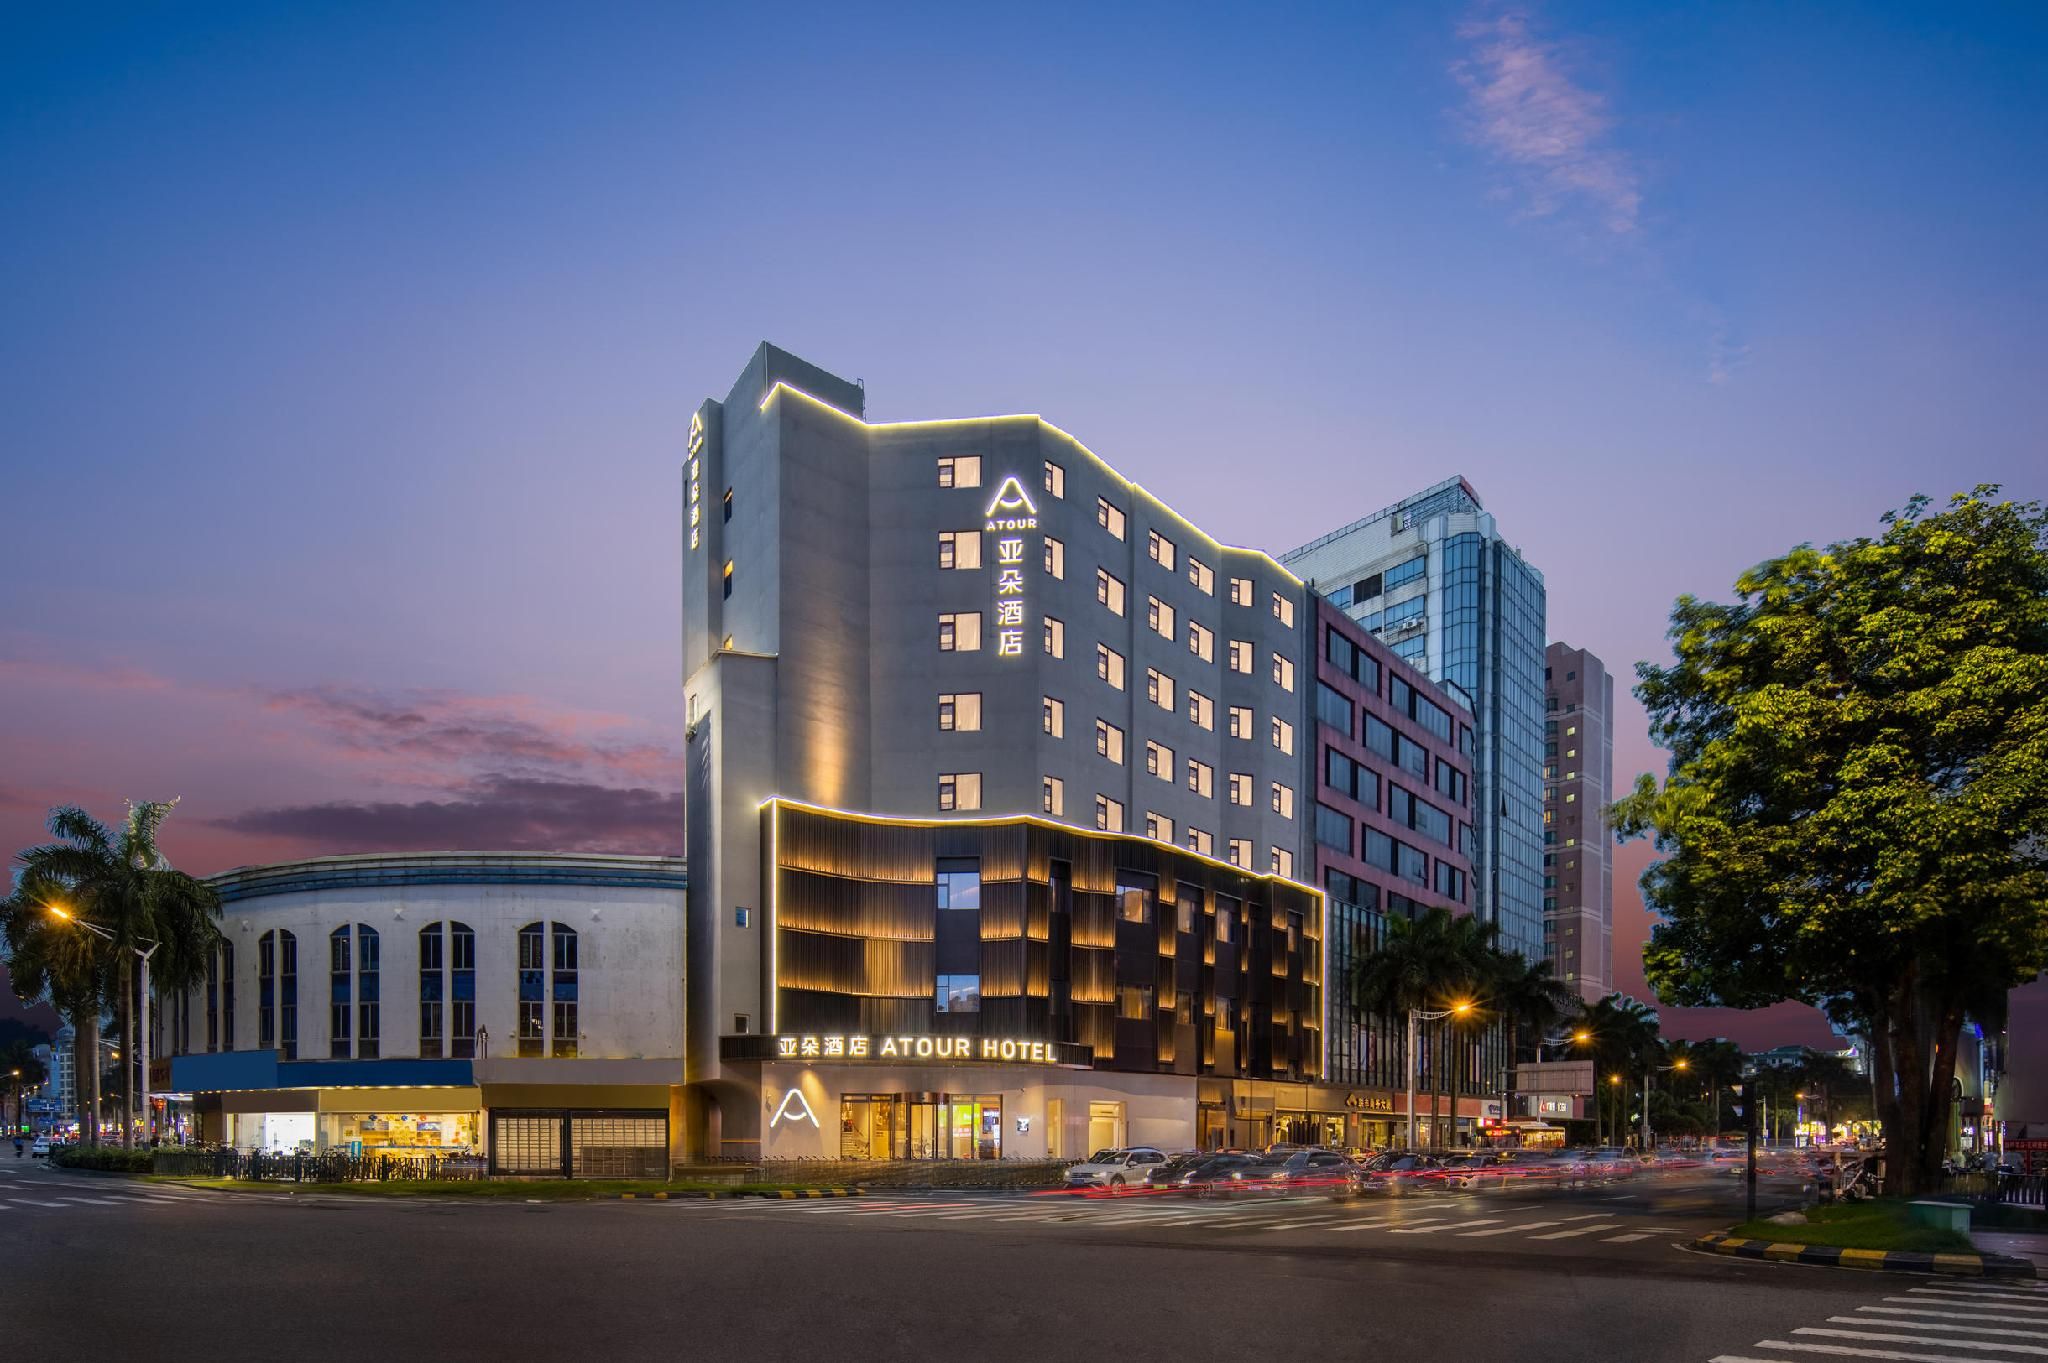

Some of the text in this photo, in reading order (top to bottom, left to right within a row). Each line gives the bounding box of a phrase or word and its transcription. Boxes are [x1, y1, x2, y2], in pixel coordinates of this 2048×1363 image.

[986, 518, 1037, 531] ATOUR
[998, 539, 1024, 656] 亚朵酒店
[779, 1036, 869, 1057] 亚朵酒店
[880, 1036, 1058, 1063] ATOUR HOTEL
